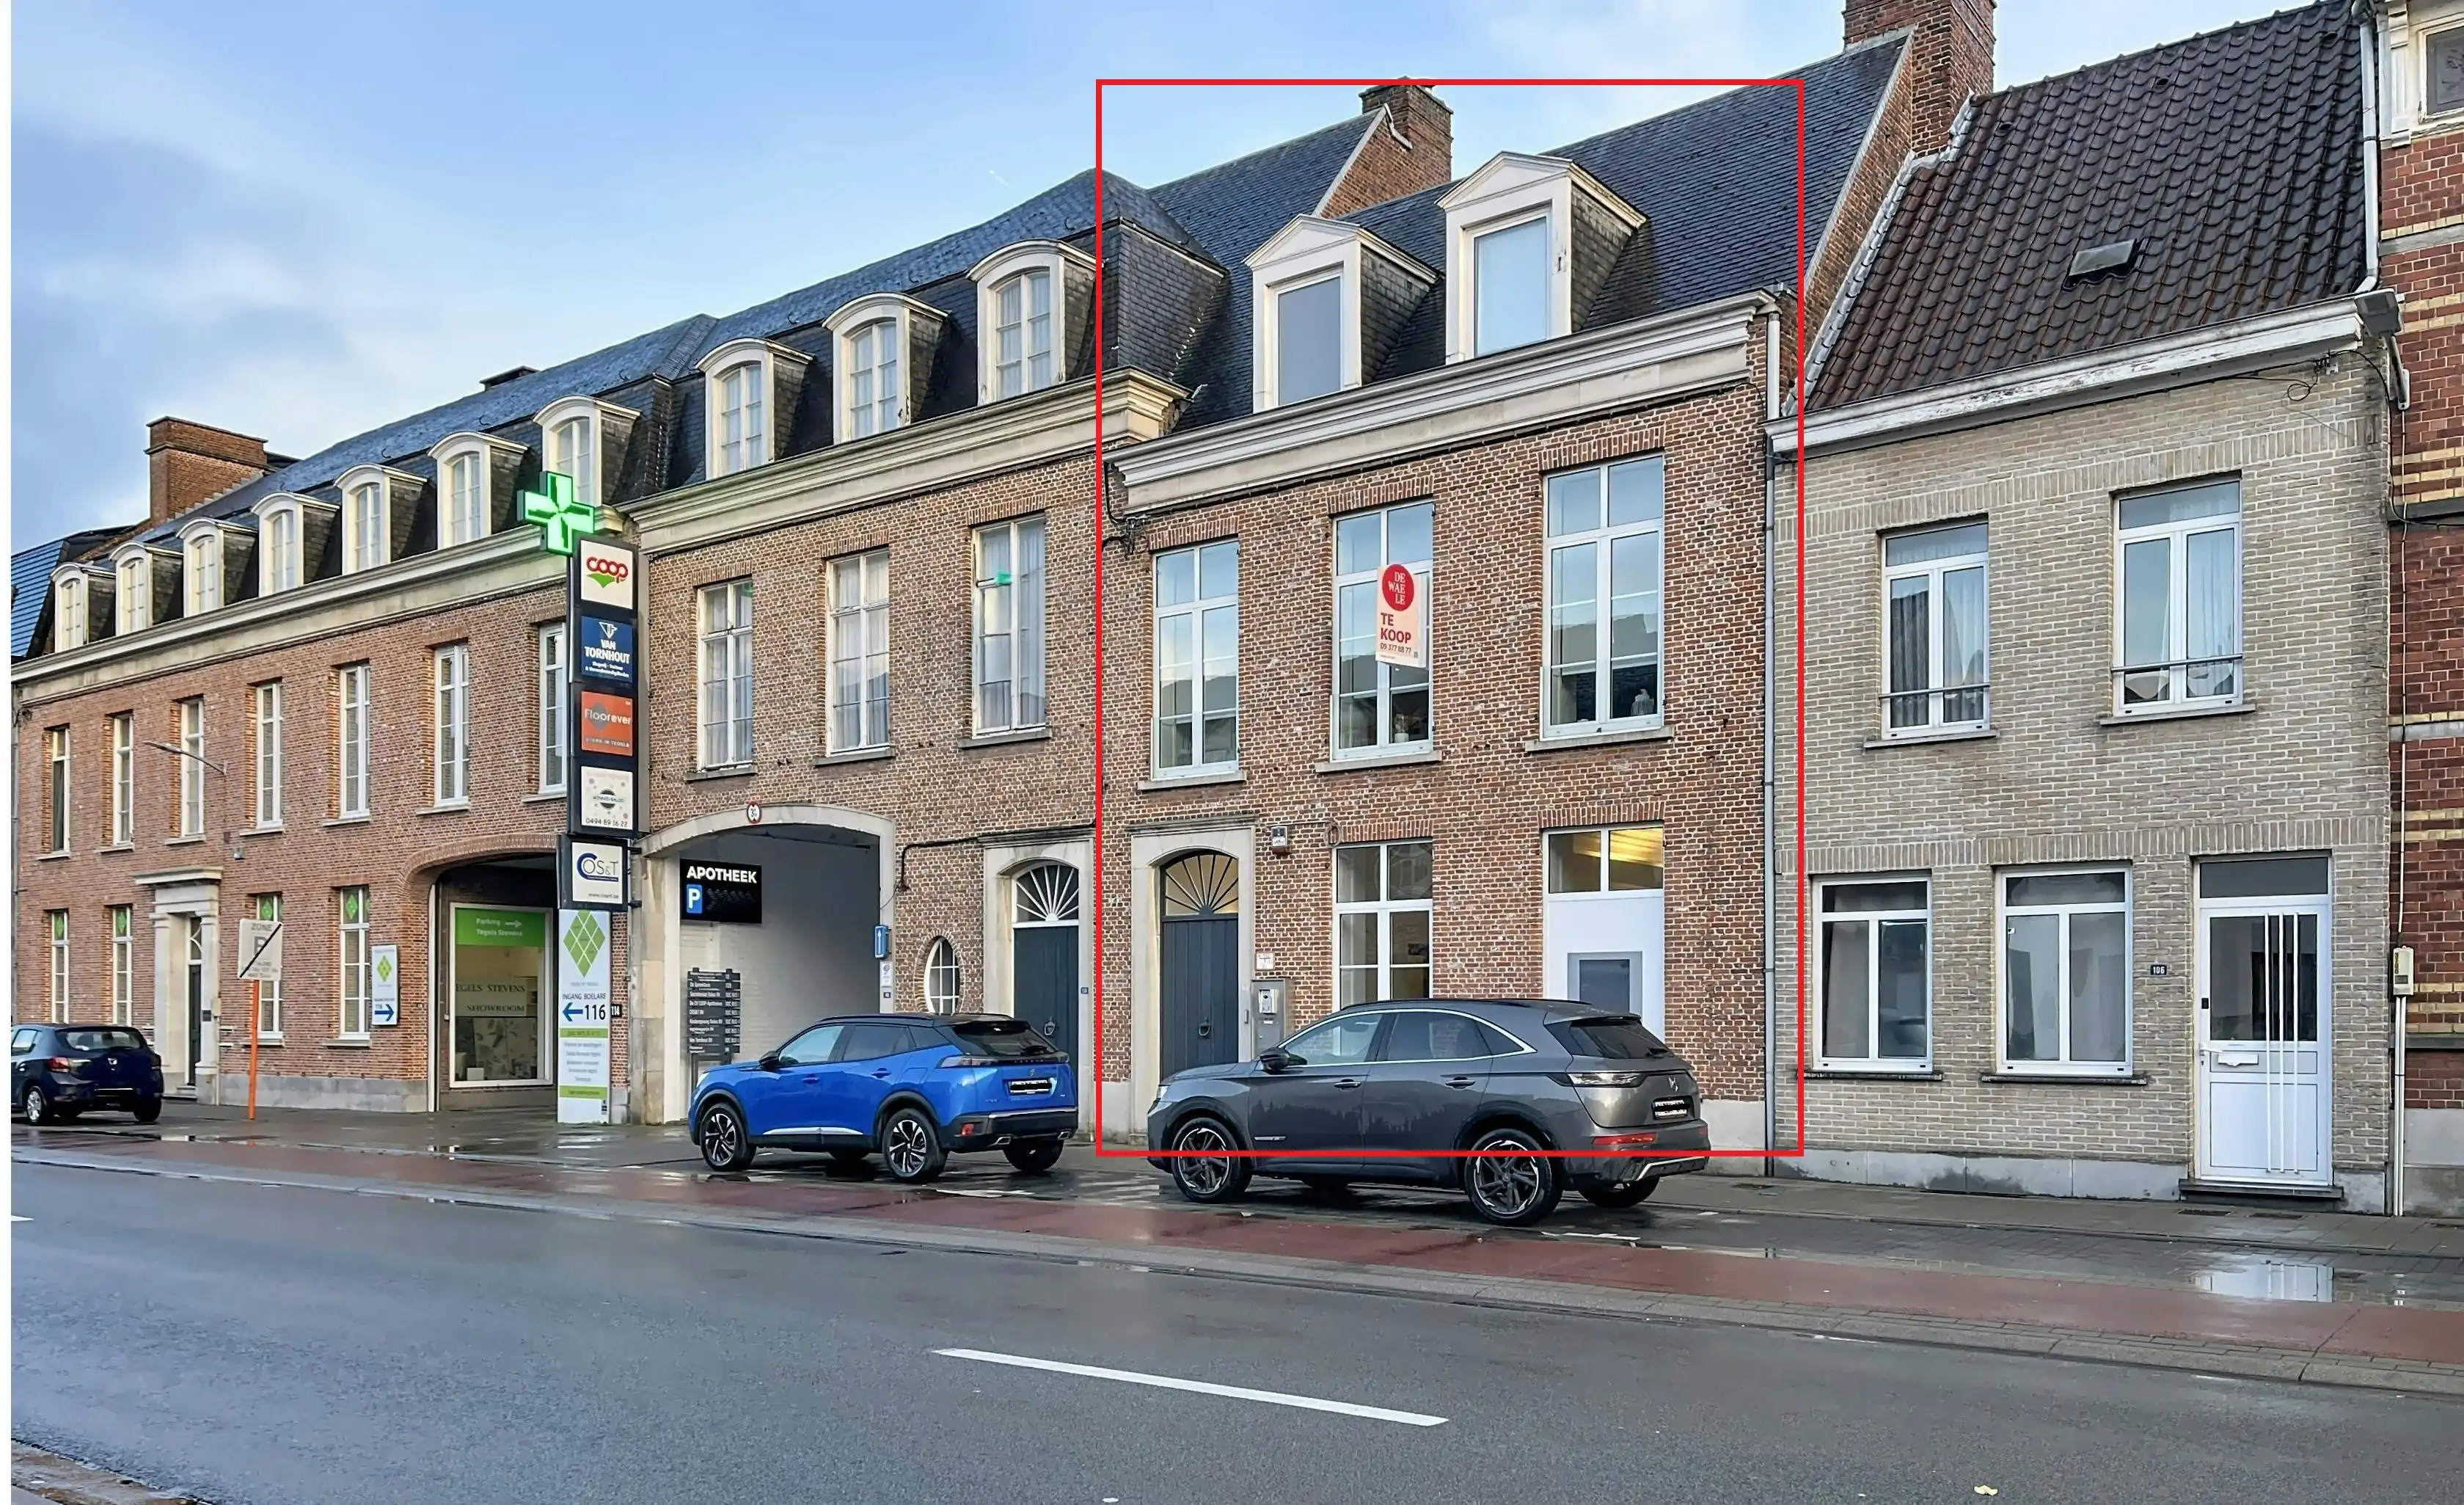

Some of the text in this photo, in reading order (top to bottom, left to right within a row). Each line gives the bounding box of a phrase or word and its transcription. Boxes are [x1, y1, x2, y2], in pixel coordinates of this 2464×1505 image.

[586, 556, 628, 583] coop
[1394, 572, 1405, 583] DE
[1388, 580, 1405, 594] WAE
[1394, 593, 1405, 605] LE
[1381, 612, 1394, 626] TE
[1381, 627, 1411, 644] KOOP
[601, 638, 616, 651] VAN
[1381, 642, 1387, 650] 09
[1388, 644, 1397, 652] 377
[585, 646, 630, 664] TORNHOUT
[585, 708, 631, 725] Floorever
[687, 866, 757, 883] APOTHEEK
[688, 888, 701, 909] P
[252, 922, 272, 932] ZONE
[2153, 966, 2165, 974] 106
[456, 984, 483, 992] EGELS
[585, 1004, 606, 1020] 116
